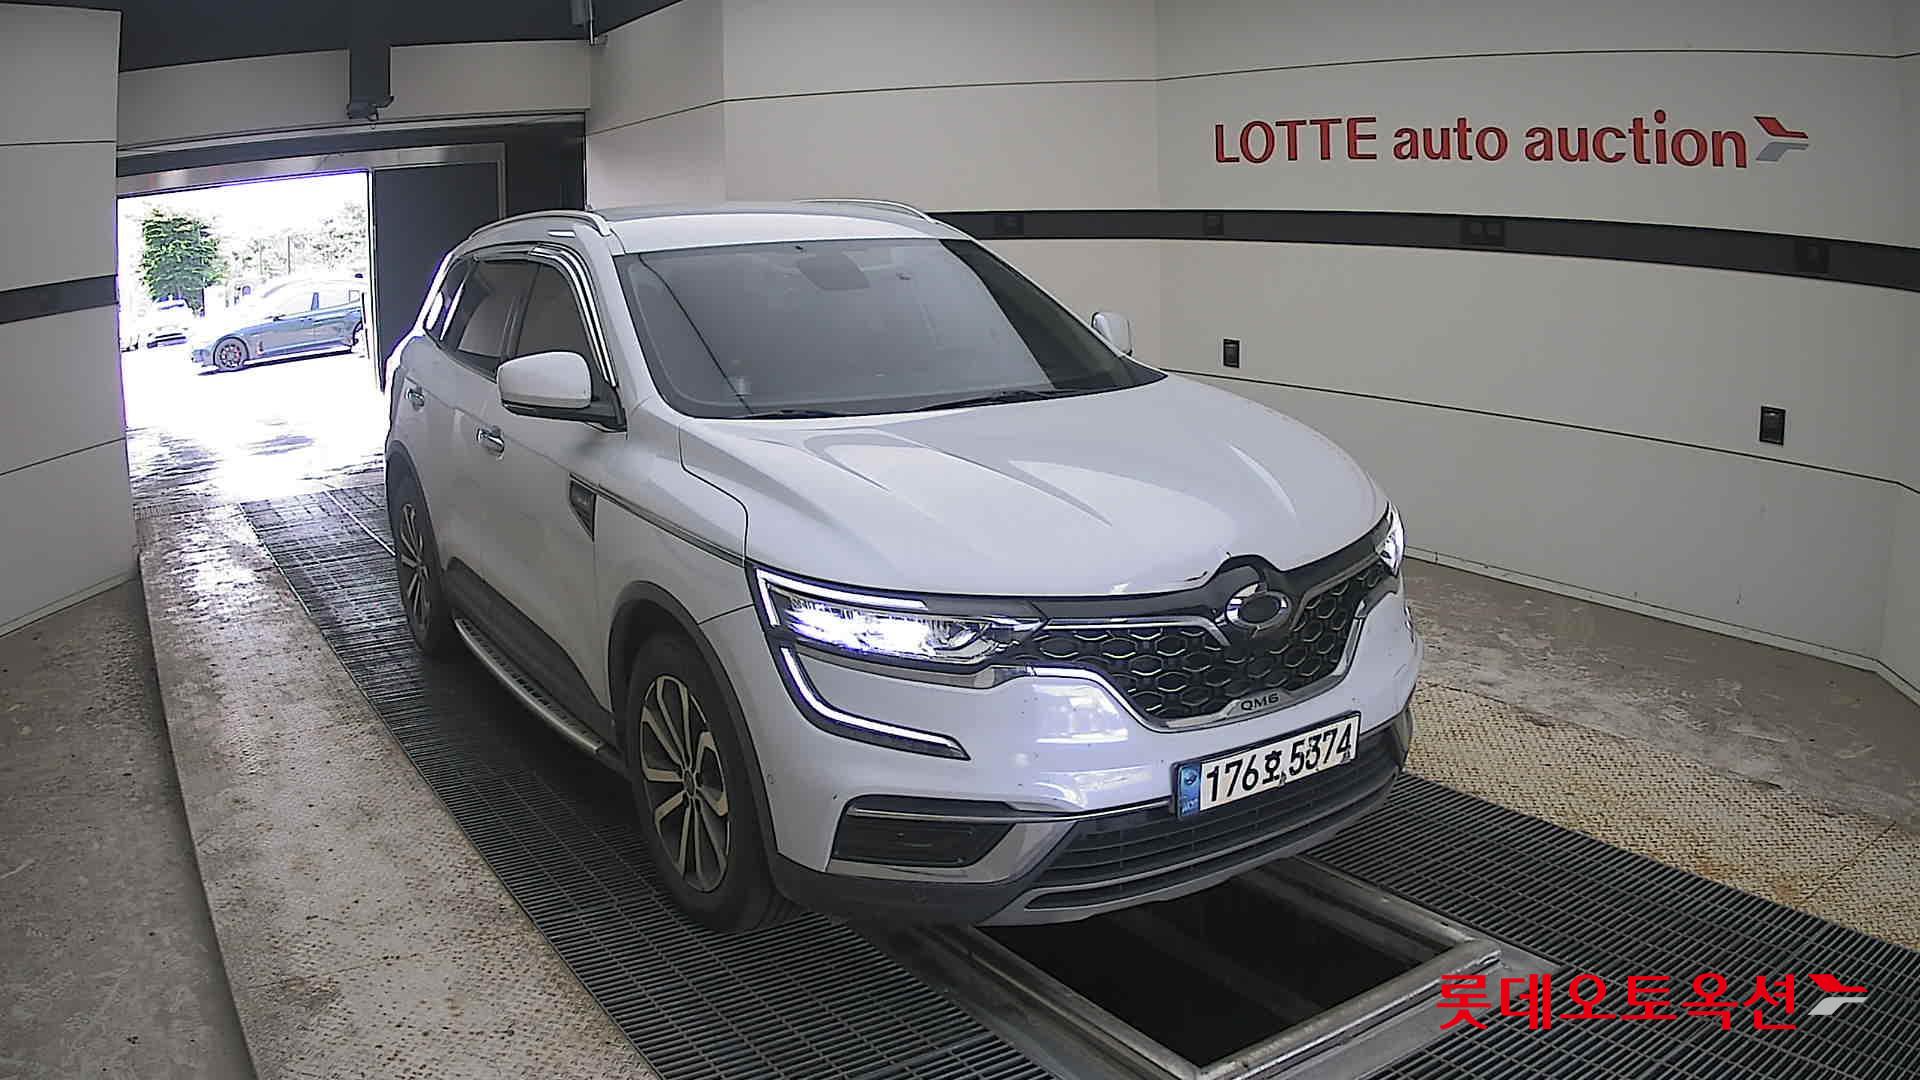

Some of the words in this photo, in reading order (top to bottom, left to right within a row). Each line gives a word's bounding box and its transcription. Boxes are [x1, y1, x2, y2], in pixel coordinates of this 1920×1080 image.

[1215, 116, 1377, 163] LOTTE
[1393, 117, 1508, 161] auto
[1524, 110, 1747, 168] auction
[1240, 692, 1280, 711] QM6
